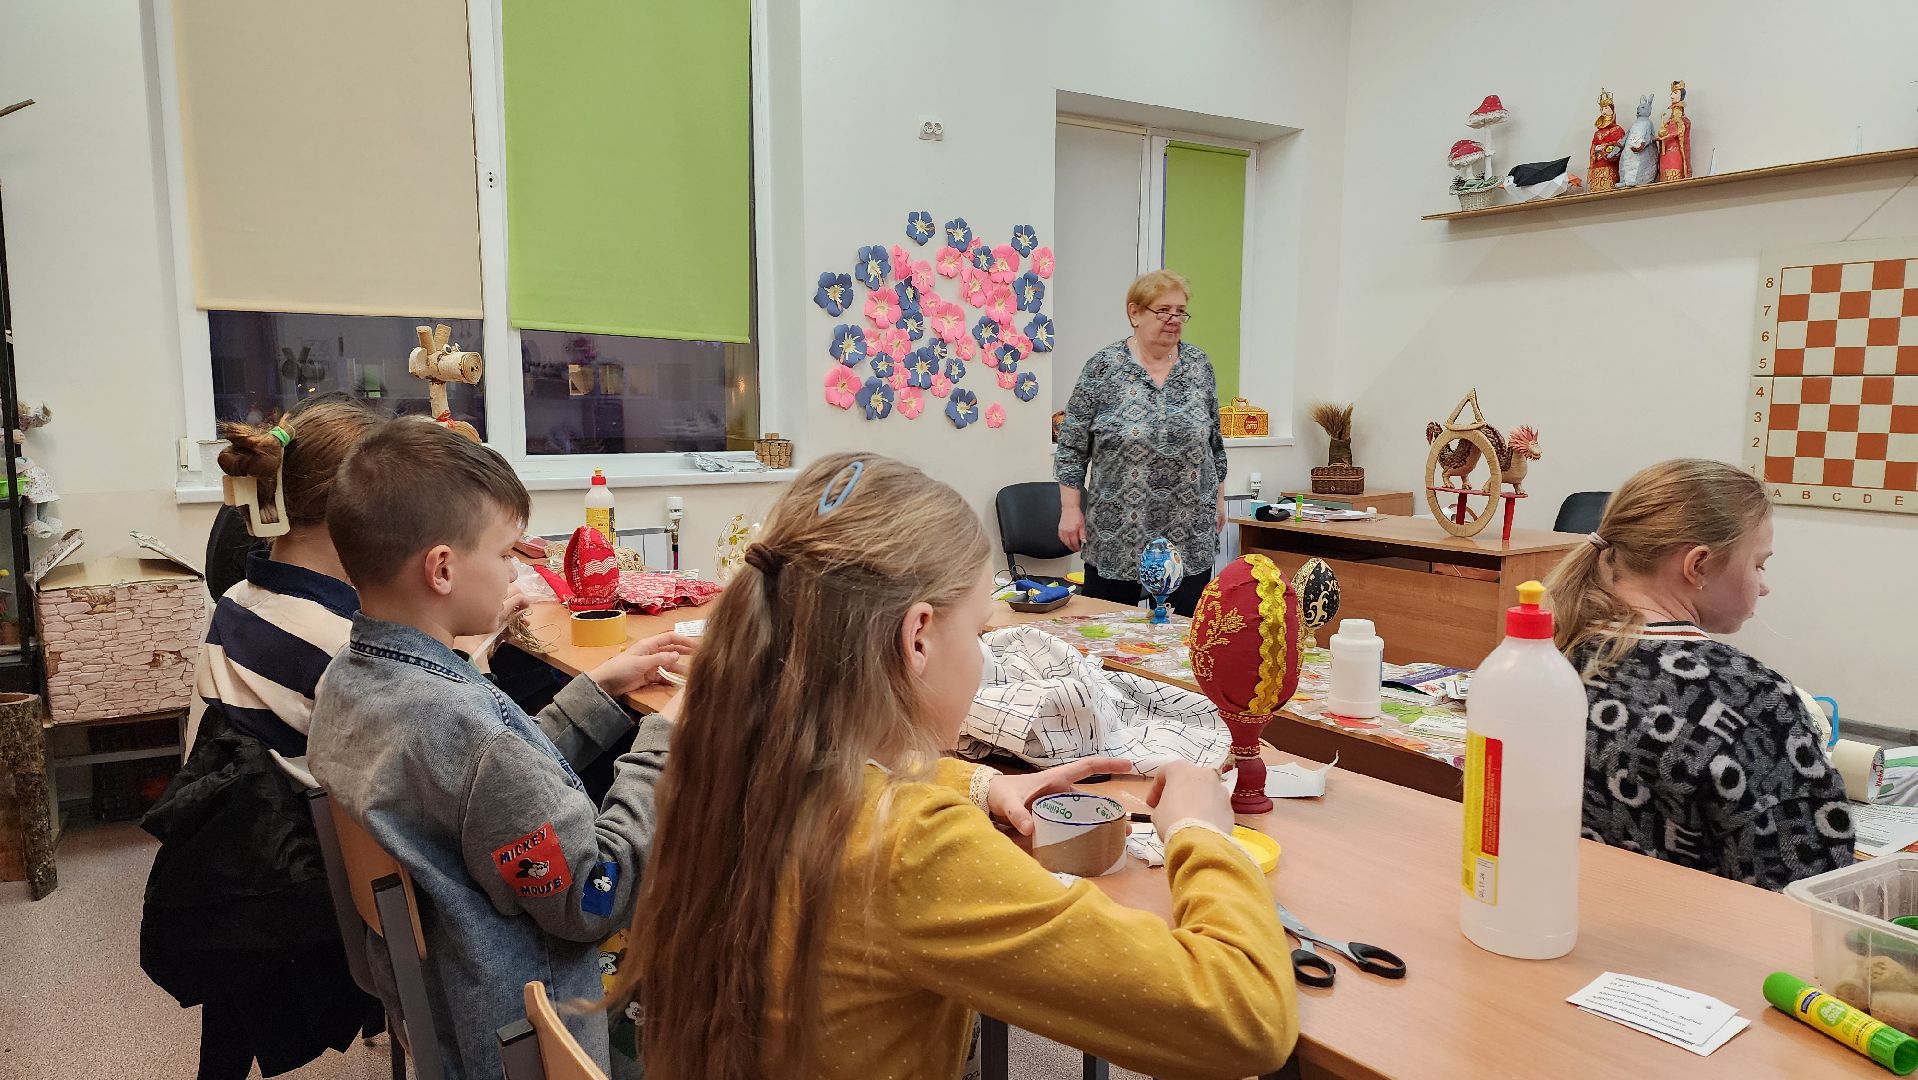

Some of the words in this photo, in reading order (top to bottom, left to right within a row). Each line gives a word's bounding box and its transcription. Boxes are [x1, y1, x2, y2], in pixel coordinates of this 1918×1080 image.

[1765, 278, 1774, 288] 8
[1763, 306, 1771, 316] 7
[1762, 331, 1769, 341] 6
[1759, 358, 1767, 368] 5
[1756, 387, 1764, 397] 4
[1754, 412, 1762, 422] 3
[1752, 438, 1760, 447] 2
[1773, 489, 1782, 498] A
[1802, 491, 1810, 500] B
[1833, 492, 1841, 502] C
[1863, 494, 1872, 504] D
[1895, 496, 1903, 506] E
[500, 828, 547, 865] MICKEY
[520, 876, 563, 894] MOUSE
